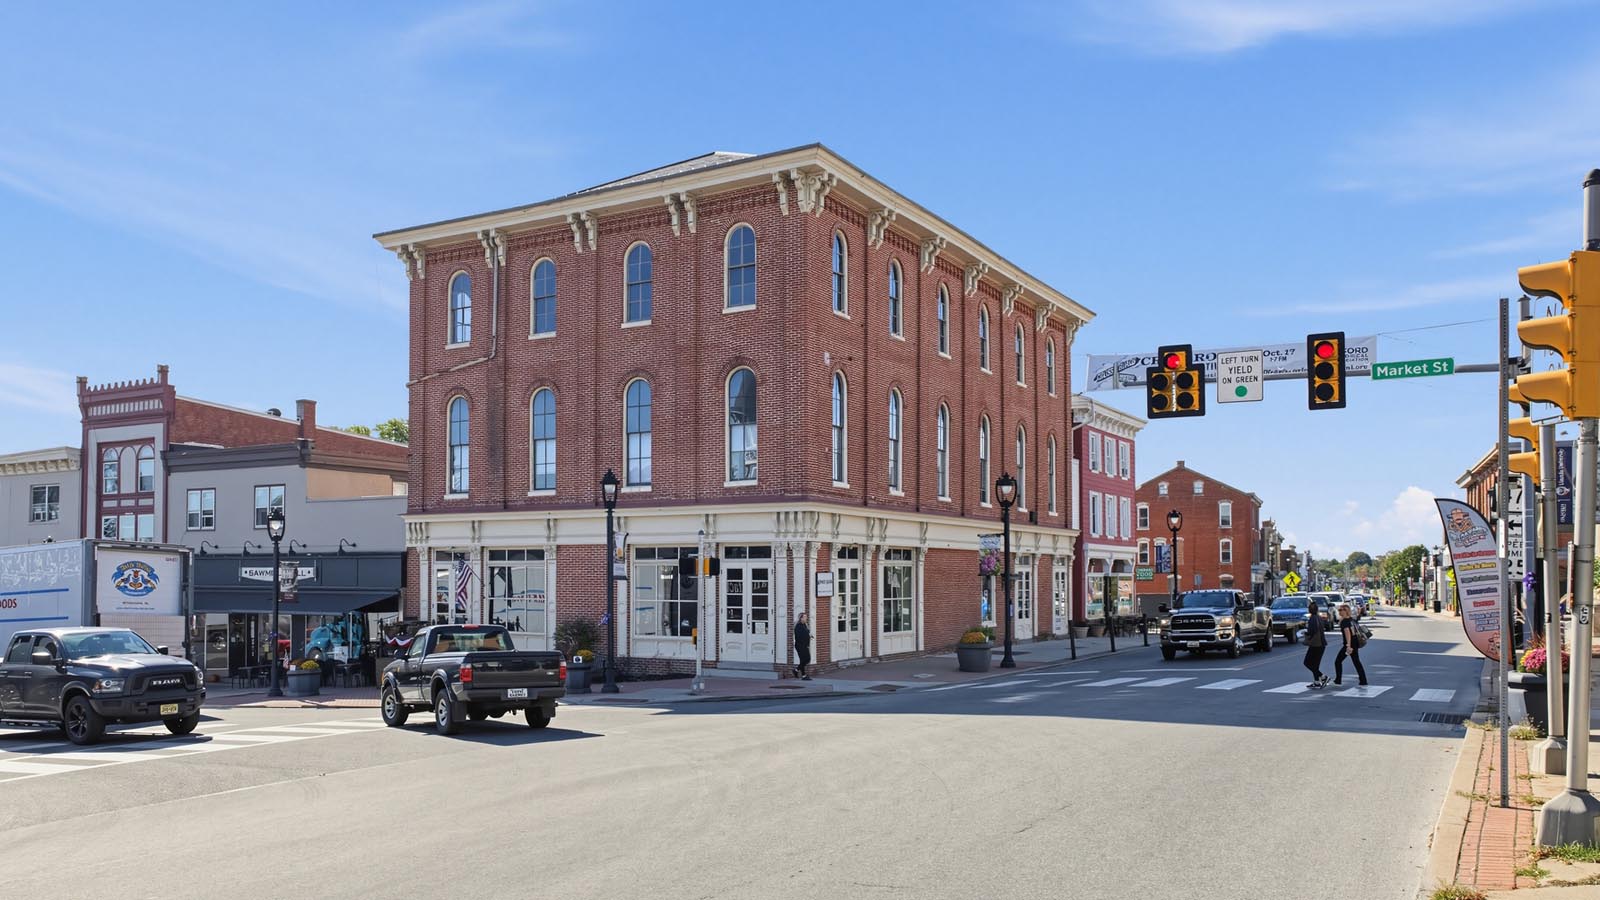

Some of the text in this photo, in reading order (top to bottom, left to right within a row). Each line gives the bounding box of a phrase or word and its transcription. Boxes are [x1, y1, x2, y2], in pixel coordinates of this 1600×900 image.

[1263, 348, 1296, 357] Oct. 17
[1220, 356, 1237, 365] LEFT
[1240, 355, 1259, 363] TURN
[1228, 365, 1253, 375] YIELD
[1376, 363, 1429, 377] Market
[1432, 361, 1449, 373] St
[1222, 375, 1258, 385] ON GREEN
[1508, 541, 1523, 549] PEE
[0, 598, 17, 609] ODS
[152, 678, 181, 686] RAM
